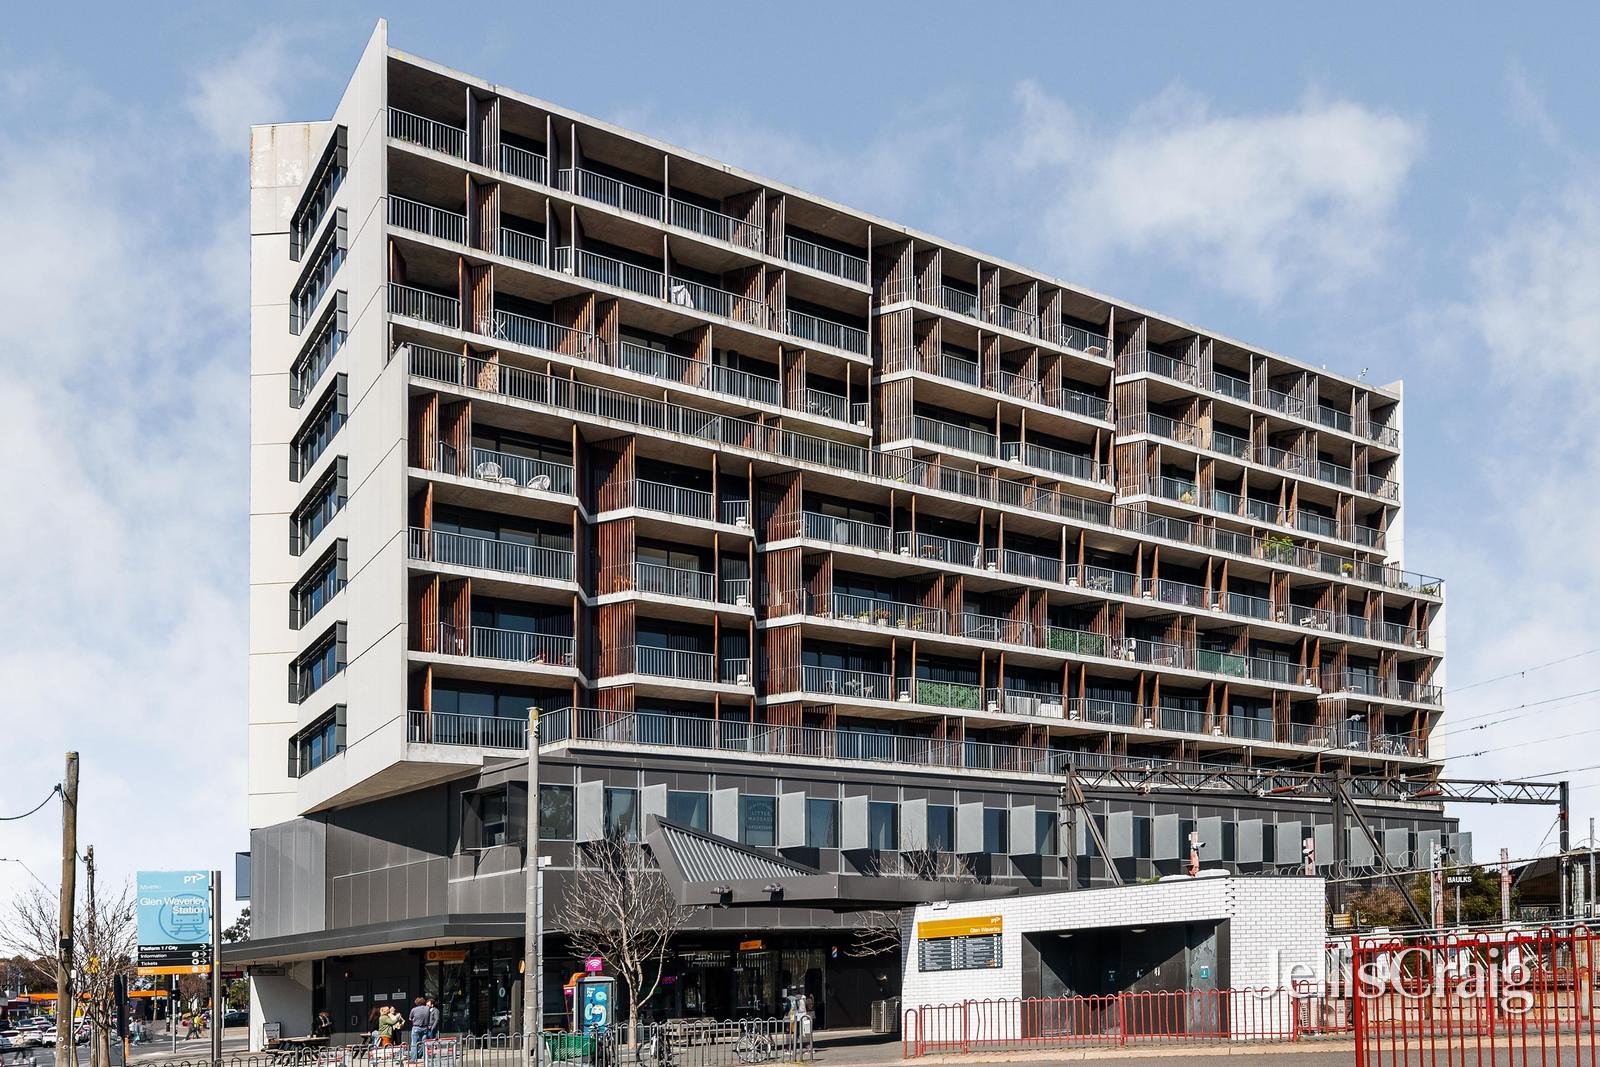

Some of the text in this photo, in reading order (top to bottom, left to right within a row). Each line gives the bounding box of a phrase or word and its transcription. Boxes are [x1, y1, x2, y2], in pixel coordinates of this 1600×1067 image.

[140, 896, 206, 907] Glen Waverley
[172, 906, 206, 914] Station
